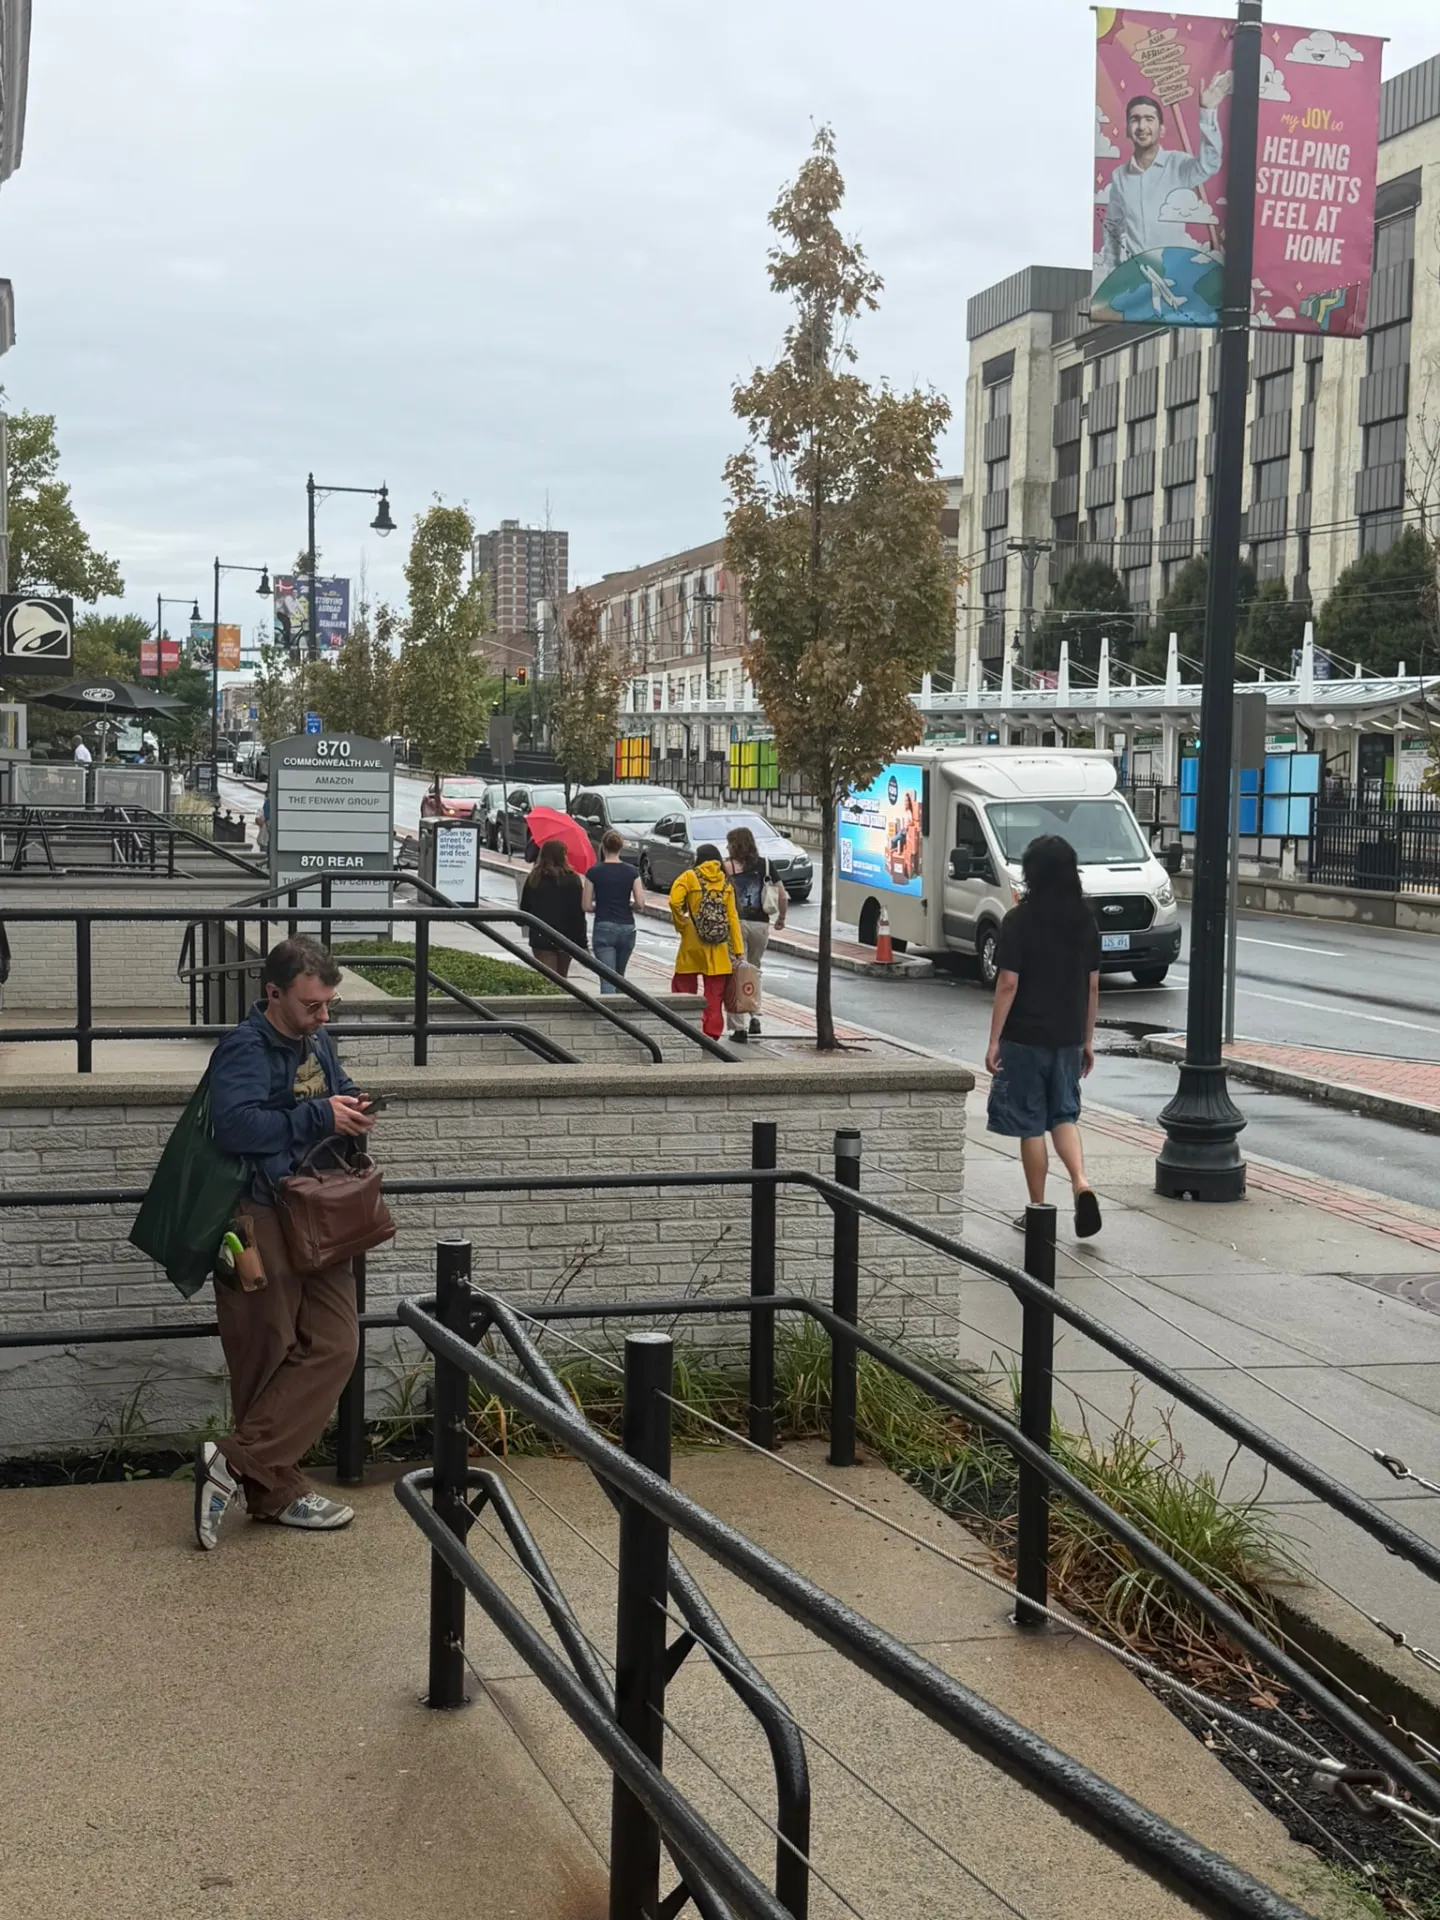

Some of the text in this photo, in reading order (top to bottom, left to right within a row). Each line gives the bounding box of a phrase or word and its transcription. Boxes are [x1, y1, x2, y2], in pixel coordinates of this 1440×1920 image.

[1149, 34, 1165, 46] ASIA
[1159, 83, 1183, 94] EUROPE
[1302, 108, 1332, 130] JOY
[1262, 135, 1350, 171] HELPING
[1256, 167, 1362, 204] STUDENTS
[1261, 199, 1342, 233] FEEL AT
[1284, 233, 1345, 265] HOME
[319, 619, 347, 628] DENMARK
[317, 740, 351, 757] 870
[283, 757, 383, 768] COMMONWEALTH AVE.
[315, 776, 354, 785] AMAZON
[288, 796, 380, 806] THE FENWAY GROUP
[301, 855, 364, 867] 870 REAR
